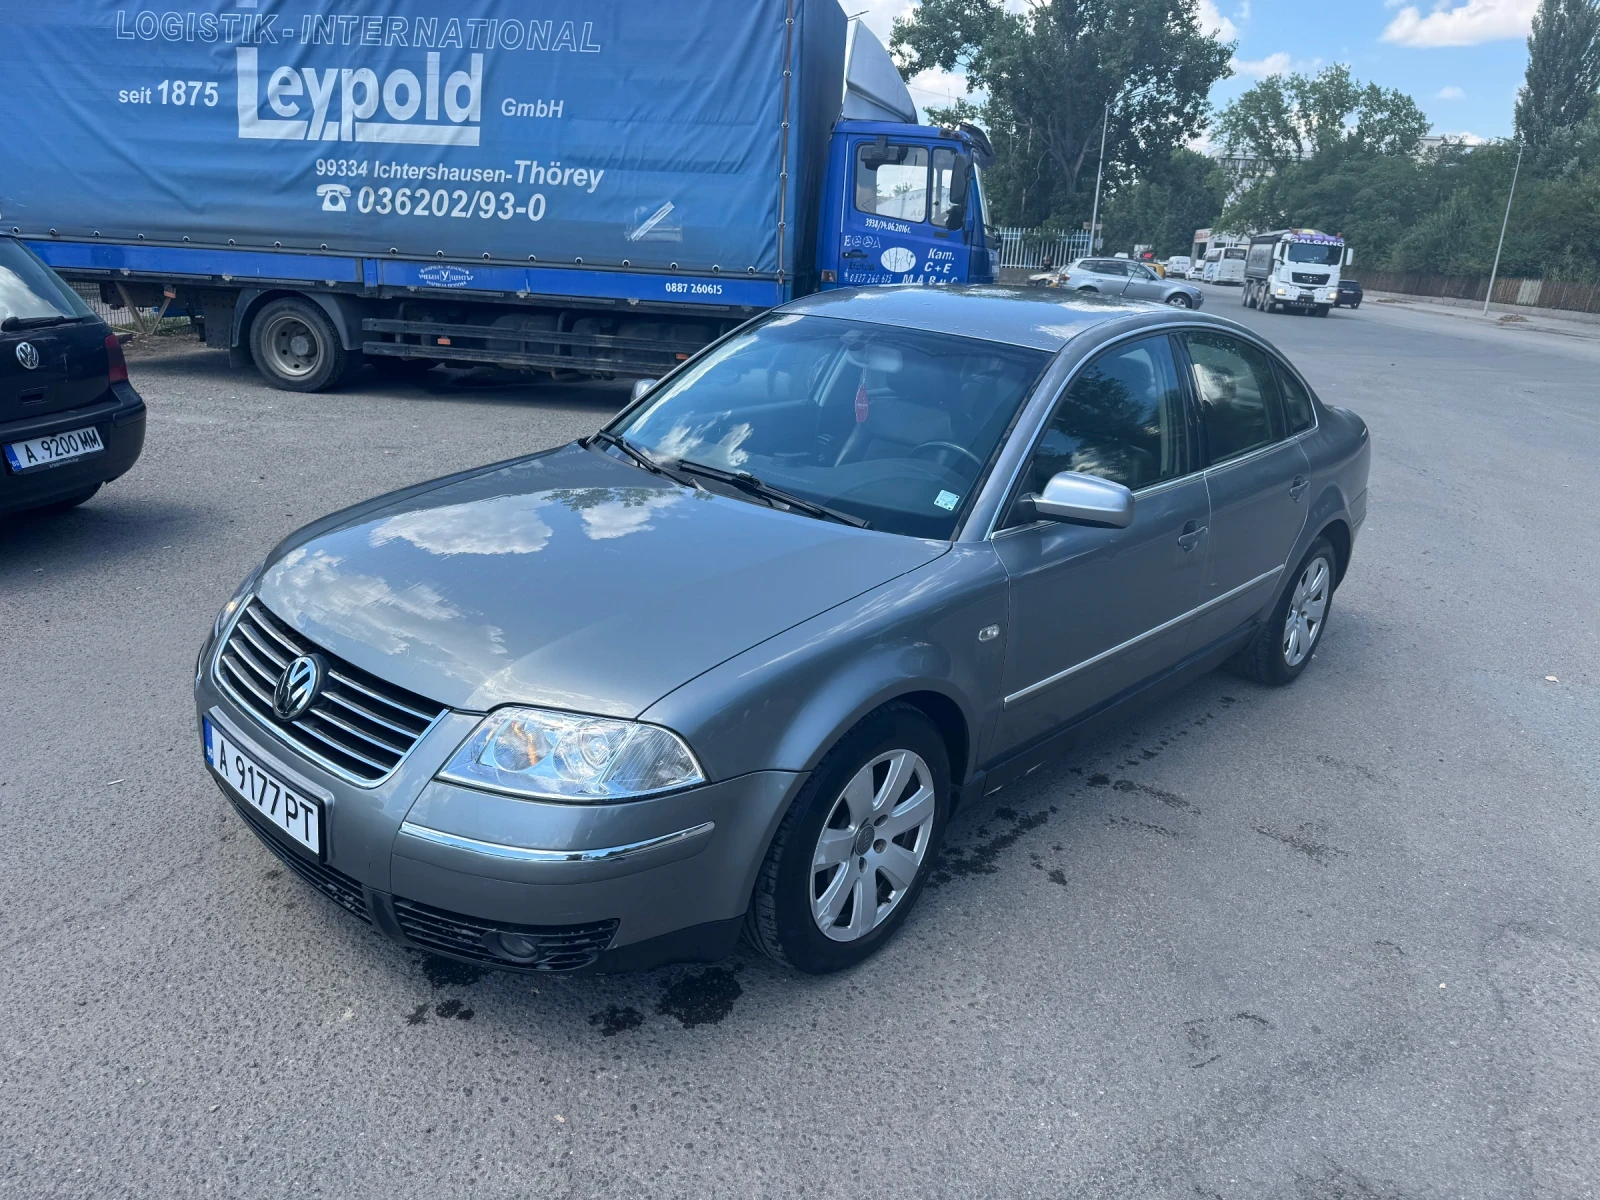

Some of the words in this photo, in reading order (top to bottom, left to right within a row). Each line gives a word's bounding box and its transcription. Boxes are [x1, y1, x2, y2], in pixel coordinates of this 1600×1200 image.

[118, 87, 151, 104] seit
[157, 79, 219, 107] 1875
[236, 47, 484, 146] Leypold
[501, 98, 564, 118] GmbH
[315, 158, 368, 177] 99334
[373, 159, 604, 194] Ichtershausen-Thörey
[357, 186, 547, 222] 036202/93-0
[665, 282, 688, 293] 0887
[691, 283, 723, 295] 260615
[24, 443, 38, 464] A
[220, 739, 229, 777] A
